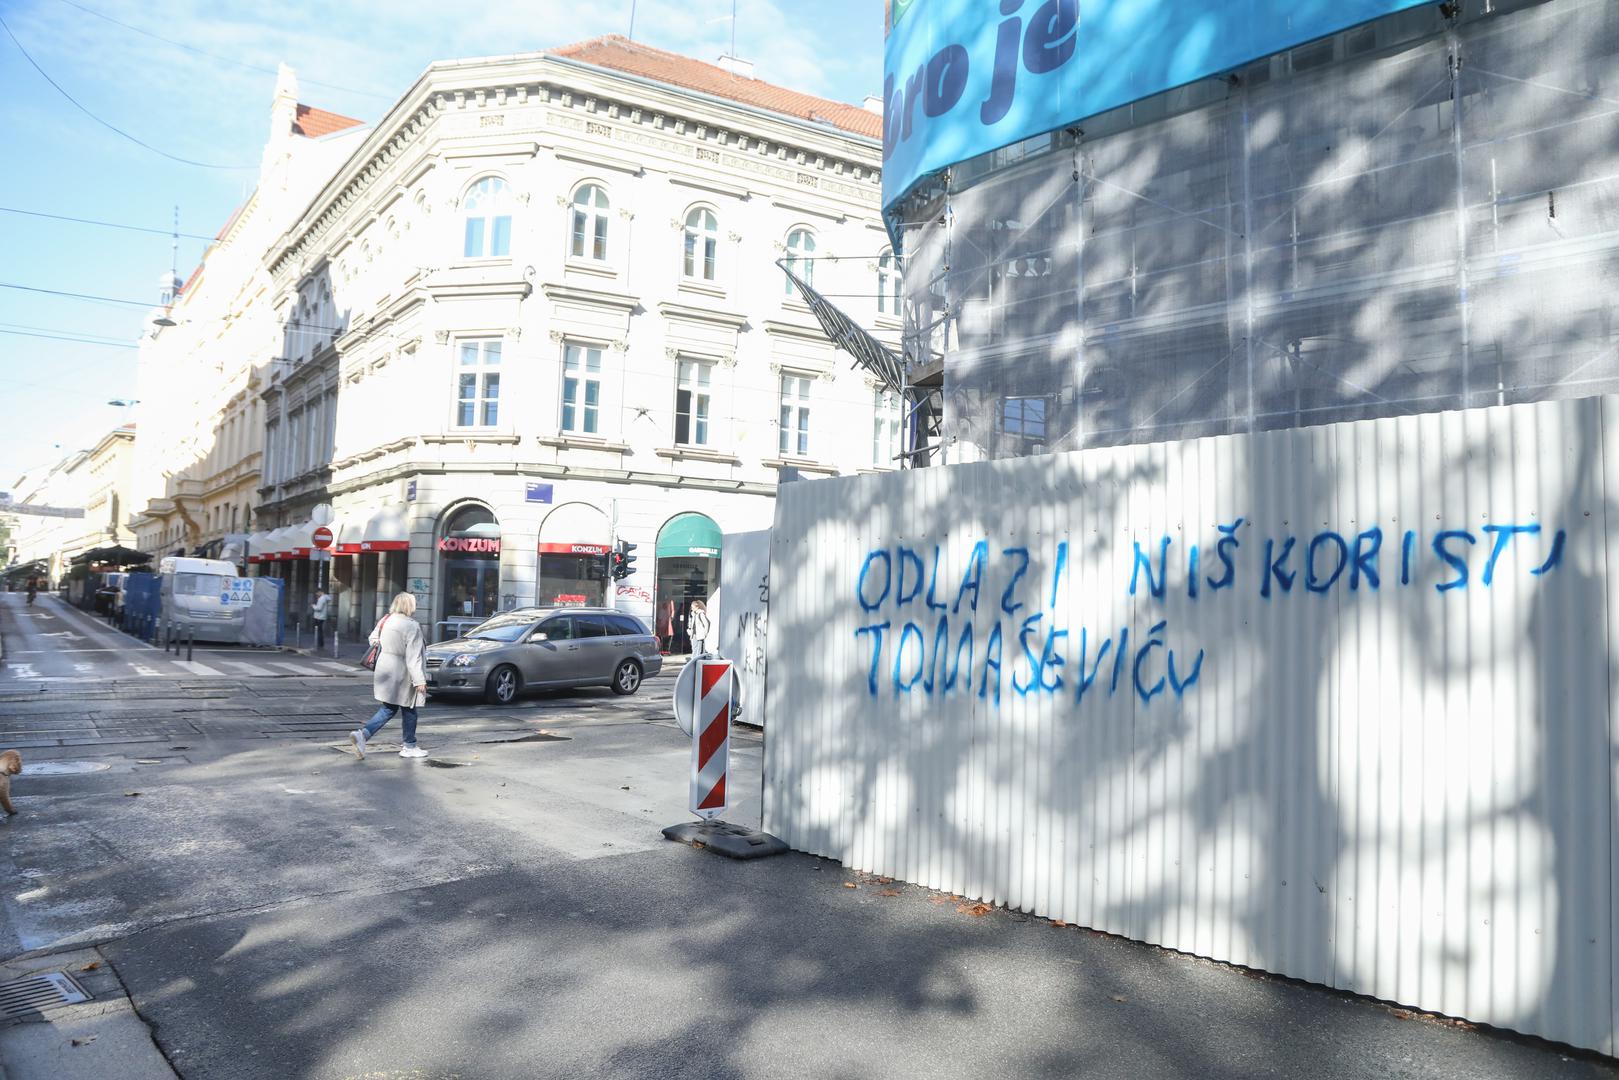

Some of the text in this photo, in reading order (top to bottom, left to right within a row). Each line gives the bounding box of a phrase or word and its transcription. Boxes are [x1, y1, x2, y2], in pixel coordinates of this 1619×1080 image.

[980, 0, 1080, 126] je
[438, 536, 500, 552] KONZUM
[571, 544, 603, 553] KONZUM
[857, 540, 1068, 613] ODLAZI
